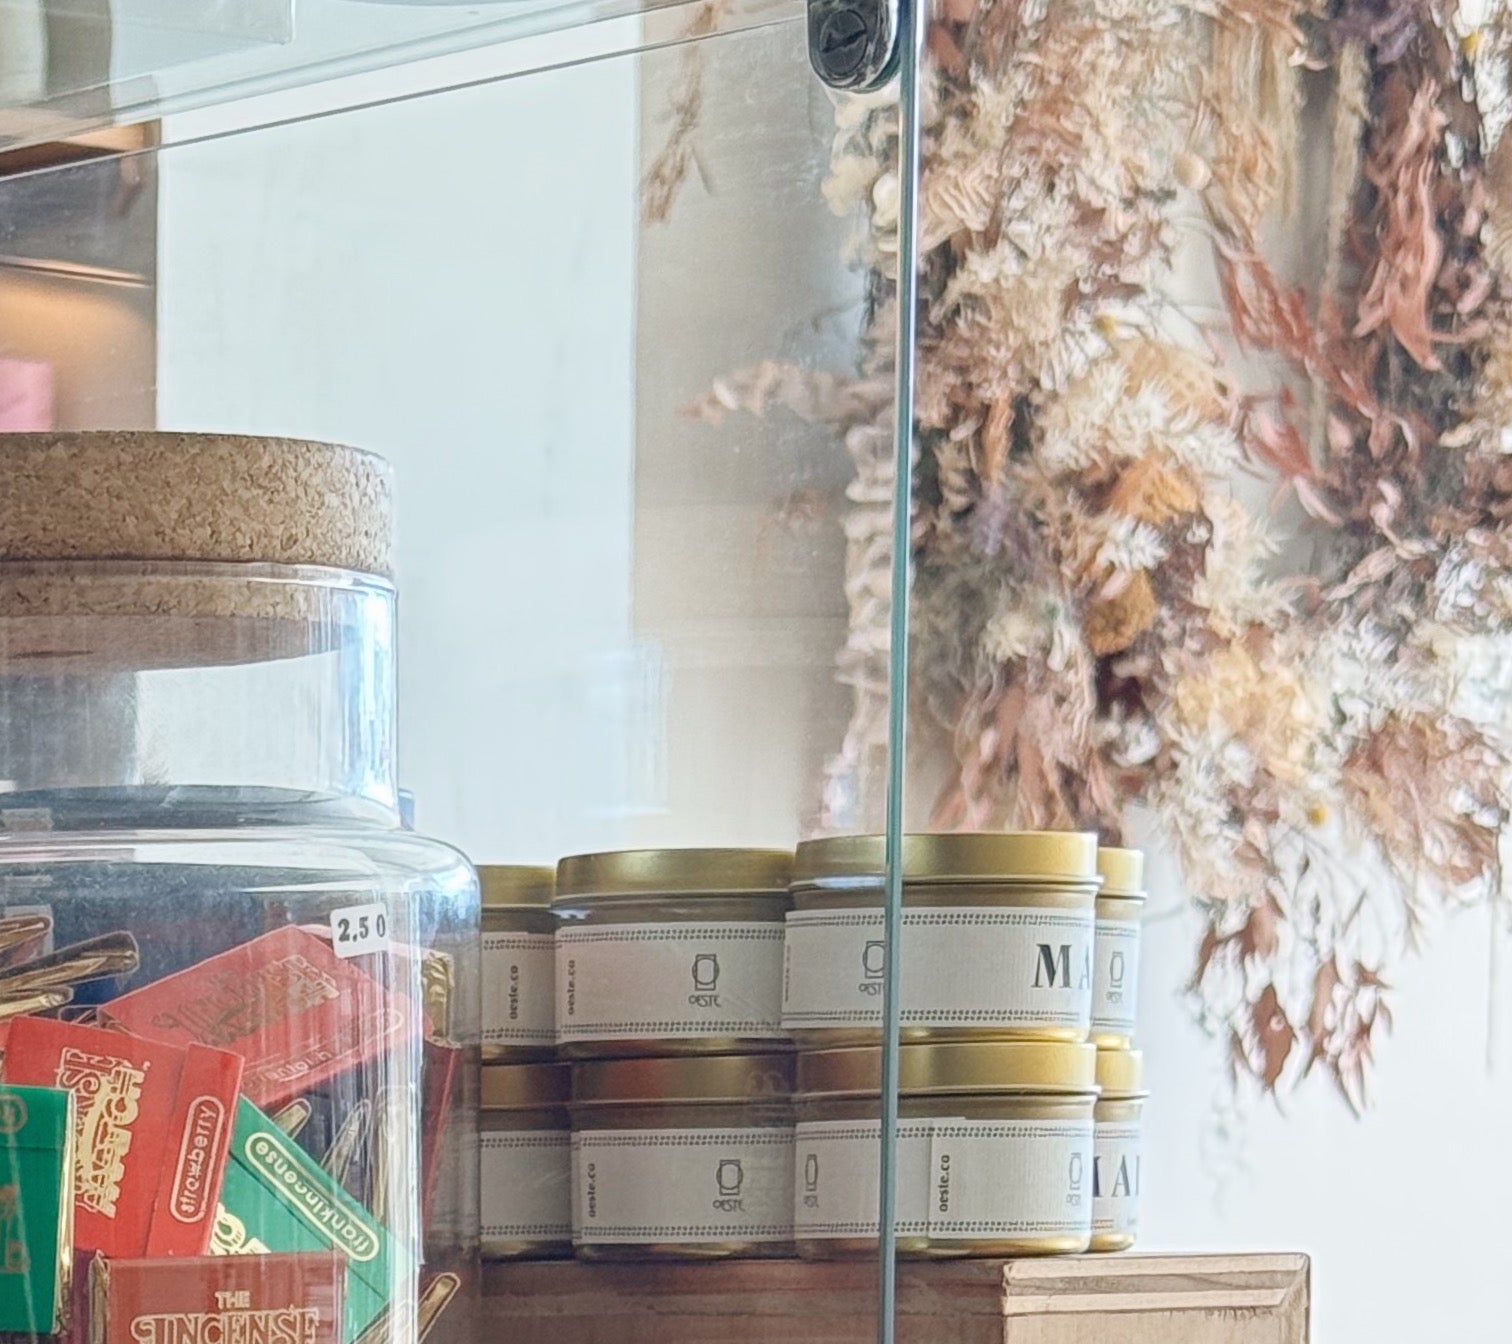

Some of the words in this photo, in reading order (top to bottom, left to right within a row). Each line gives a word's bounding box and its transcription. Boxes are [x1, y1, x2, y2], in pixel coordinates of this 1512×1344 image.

[337, 913, 386, 942] 2.50
[179, 1104, 217, 1214] strawberry
[937, 1154, 951, 1213] oeste.co
[254, 1139, 372, 1252] frankincense
[215, 1291, 251, 1309] THE
